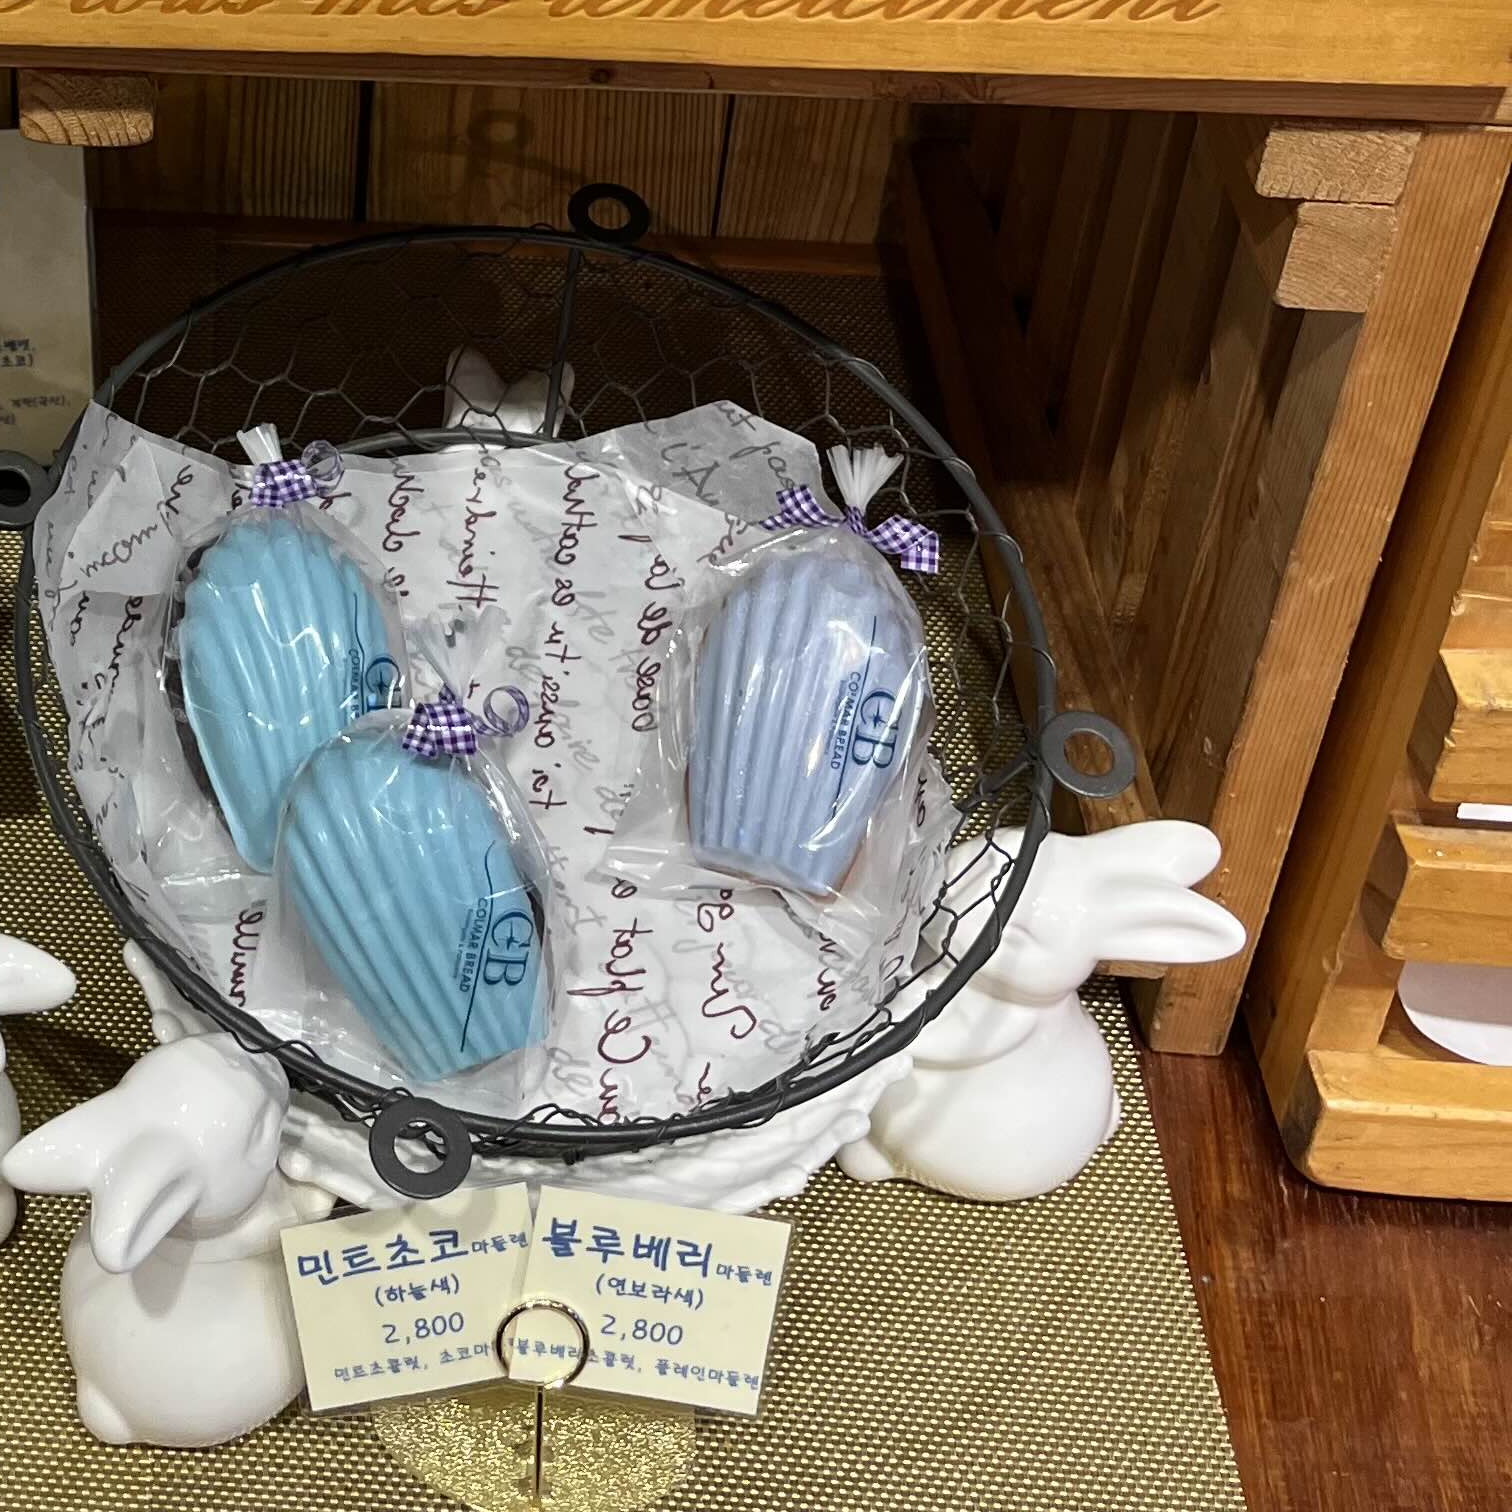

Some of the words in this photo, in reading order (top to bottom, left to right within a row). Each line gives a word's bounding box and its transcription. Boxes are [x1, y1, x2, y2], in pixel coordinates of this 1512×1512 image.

[297, 1229, 469, 1286] 민트초코
[471, 1231, 529, 1255] 마들렌
[541, 1216, 713, 1278] 블루베리
[715, 1263, 773, 1287] 마들렌
[375, 1273, 460, 1307] (하늘색)
[595, 1272, 705, 1311] (연보라색)
[382, 1311, 465, 1344] 2,800
[600, 1314, 684, 1347] 2,800
[440, 1342, 490, 1364] 초코마
